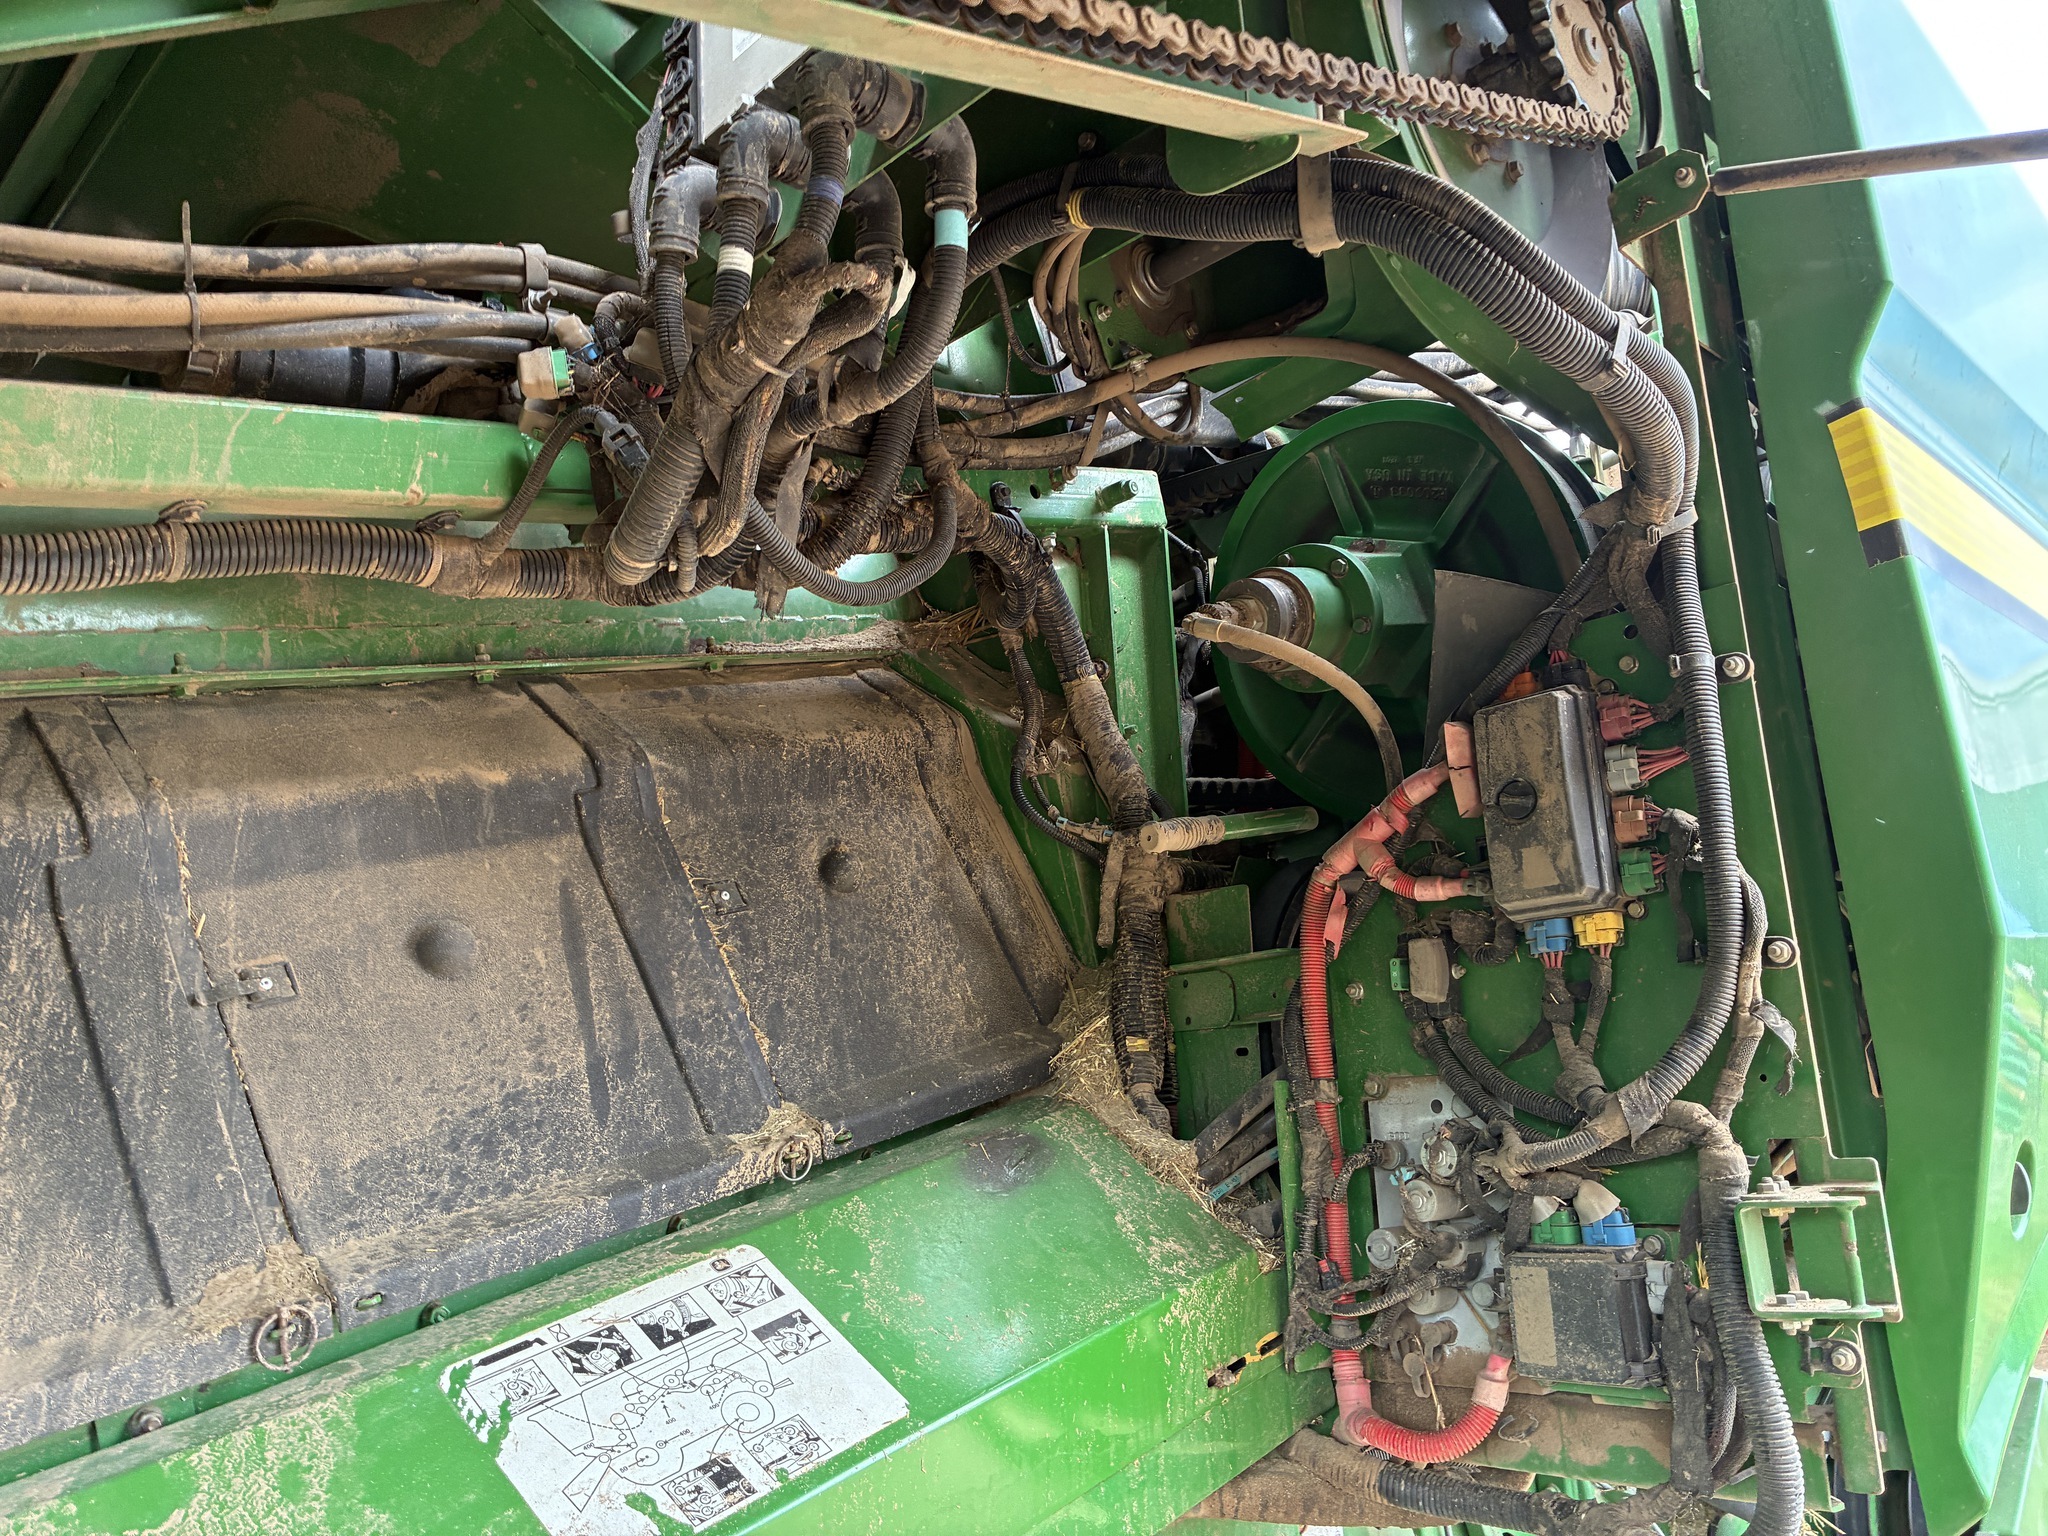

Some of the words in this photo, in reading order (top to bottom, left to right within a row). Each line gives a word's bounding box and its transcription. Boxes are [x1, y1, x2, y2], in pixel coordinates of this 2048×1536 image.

[1365, 468, 1390, 481] USA
[665, 1417, 677, 1425] 400
[679, 1428, 691, 1436] 400
[583, 1442, 595, 1451] 400
